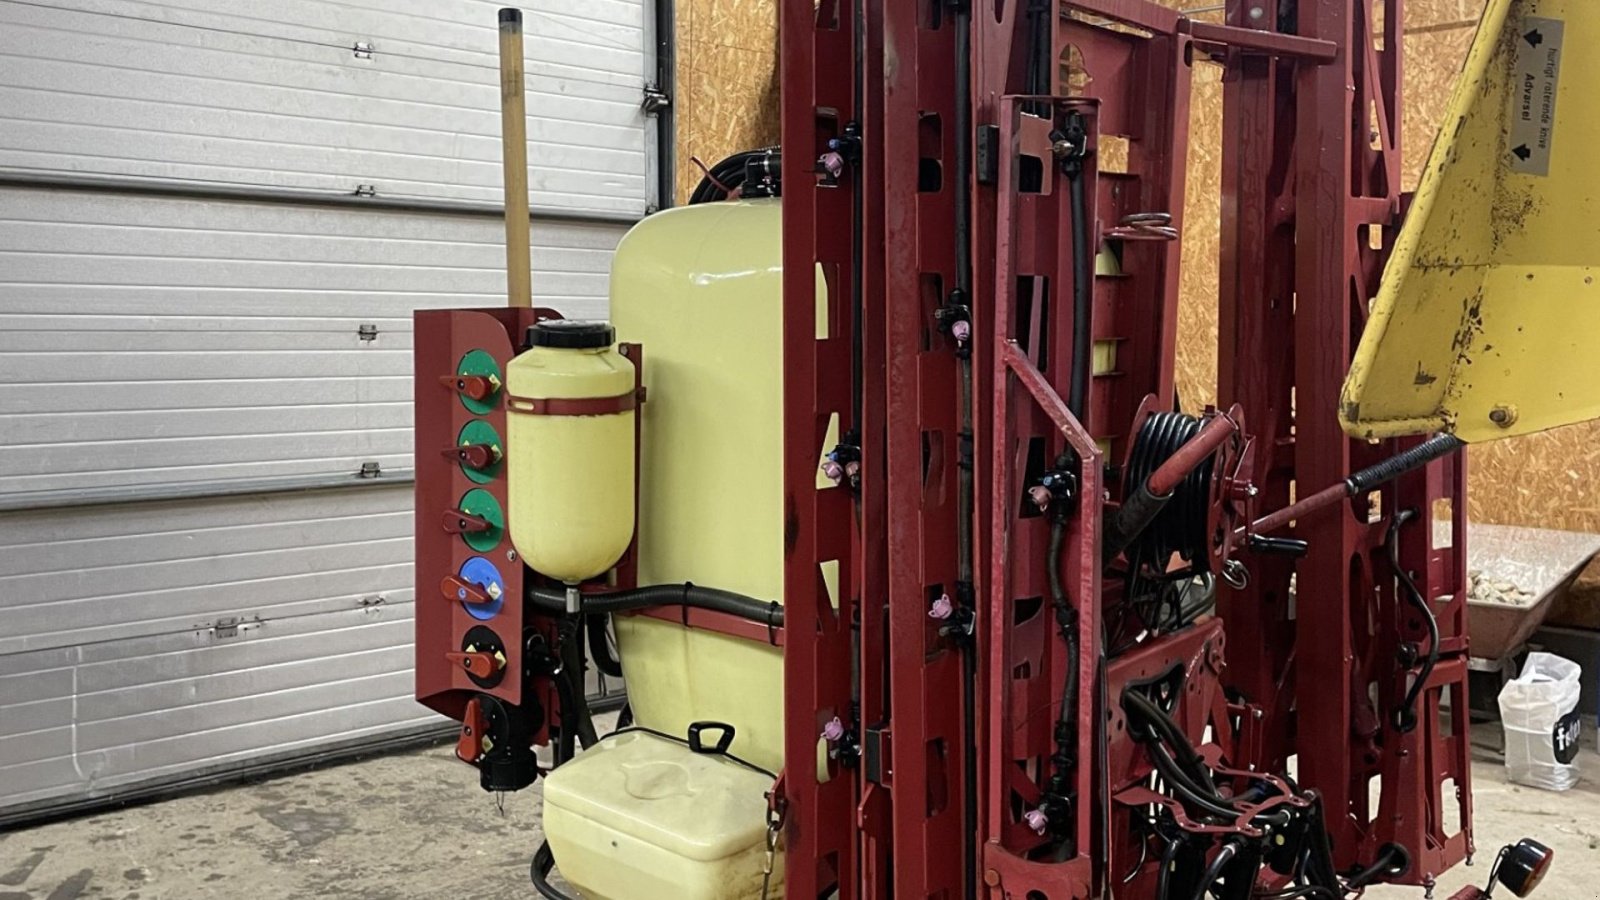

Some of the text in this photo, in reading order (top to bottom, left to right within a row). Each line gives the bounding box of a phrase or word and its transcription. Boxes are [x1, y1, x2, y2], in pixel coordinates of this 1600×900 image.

[1522, 73, 1535, 121] Advarsel
[1538, 48, 1558, 149] hurtigt roterende knive
